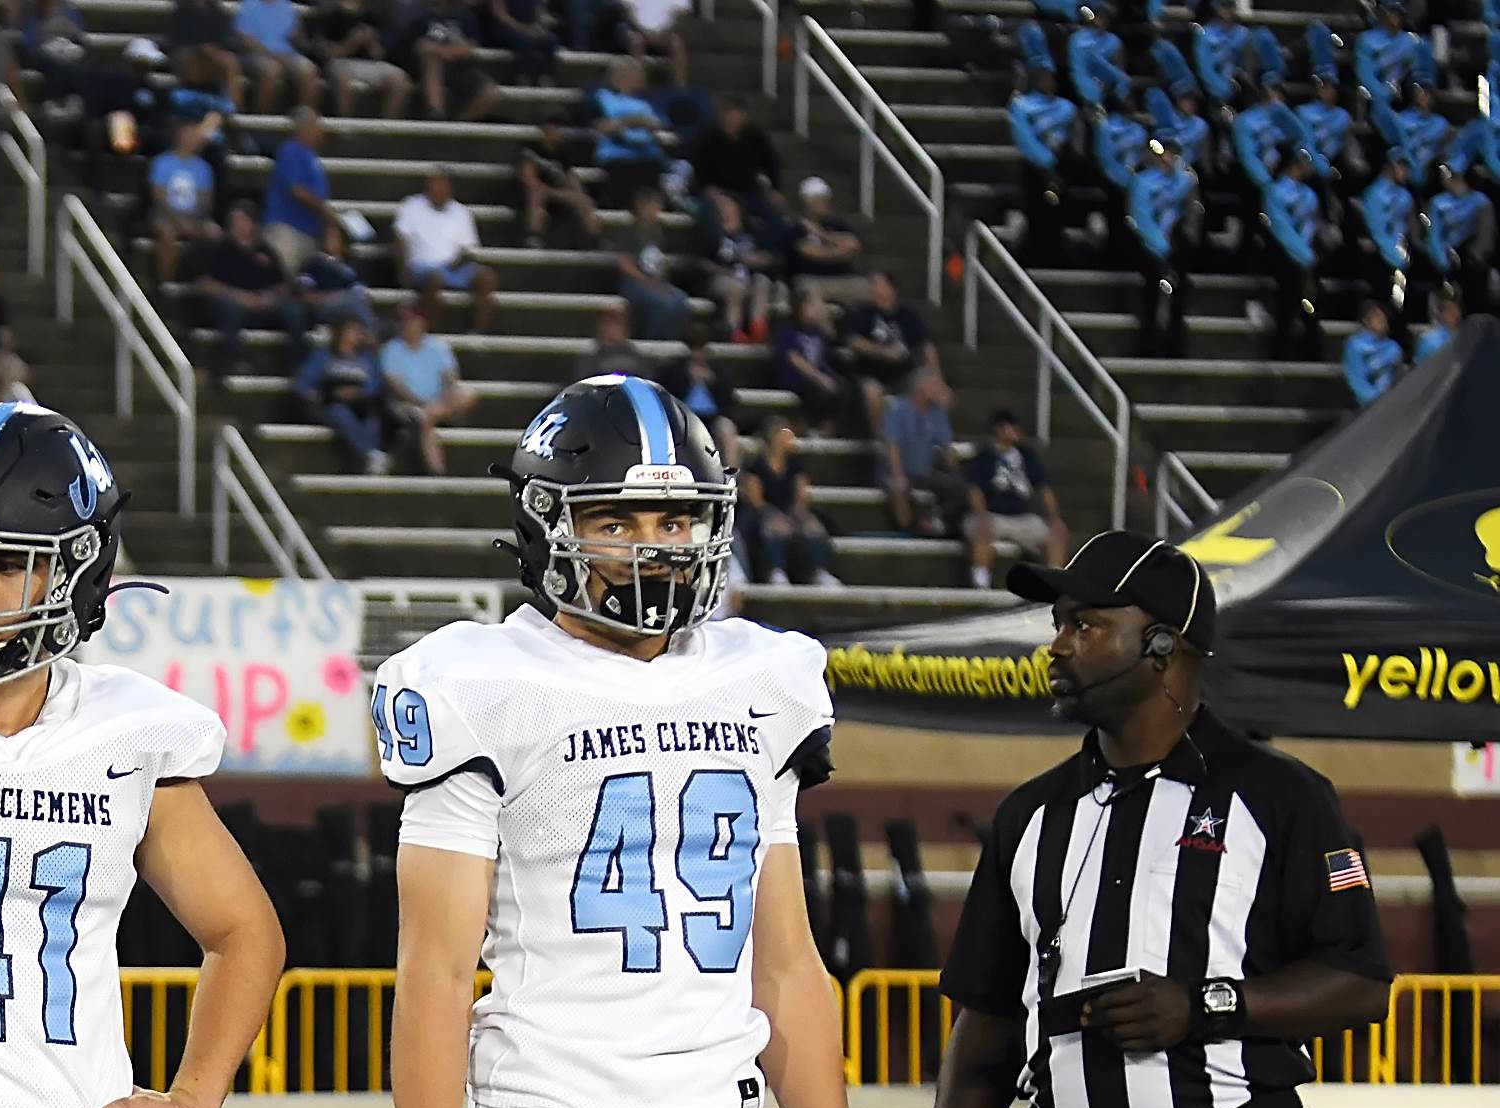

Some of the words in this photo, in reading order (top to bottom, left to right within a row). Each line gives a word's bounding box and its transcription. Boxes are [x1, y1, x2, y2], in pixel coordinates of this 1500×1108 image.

[563, 722, 647, 763] JAMES
[656, 722, 760, 753] CLEMENS
[0, 787, 112, 826] CLEMENS
[570, 770, 760, 973] 49
